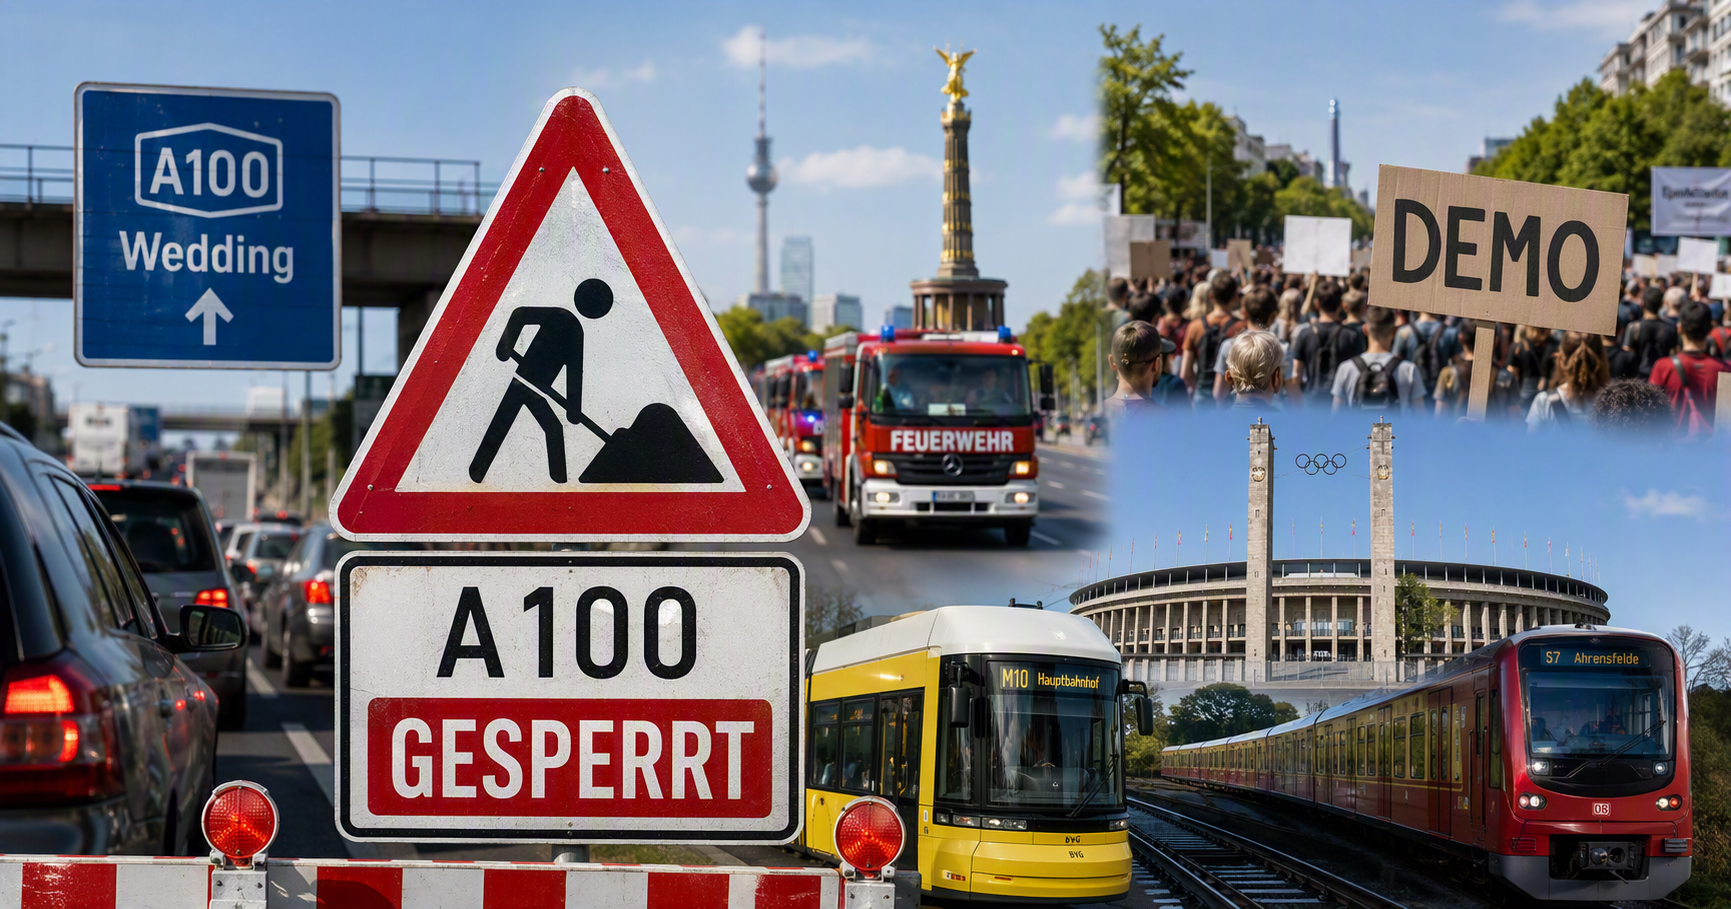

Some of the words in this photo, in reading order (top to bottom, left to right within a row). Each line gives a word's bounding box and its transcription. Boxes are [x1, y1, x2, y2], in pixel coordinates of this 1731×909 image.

[149, 147, 269, 198] A100
[118, 230, 294, 284] Wedding
[1391, 198, 1600, 303] DEMO
[890, 430, 1014, 452] FEUERWEHR
[1002, 668, 1029, 689] M10
[1037, 671, 1100, 689] Hauptbahnhof
[1545, 650, 1561, 664] S7
[1574, 652, 1640, 665] Ahrensfelde
[391, 717, 755, 800] GESPERRT
